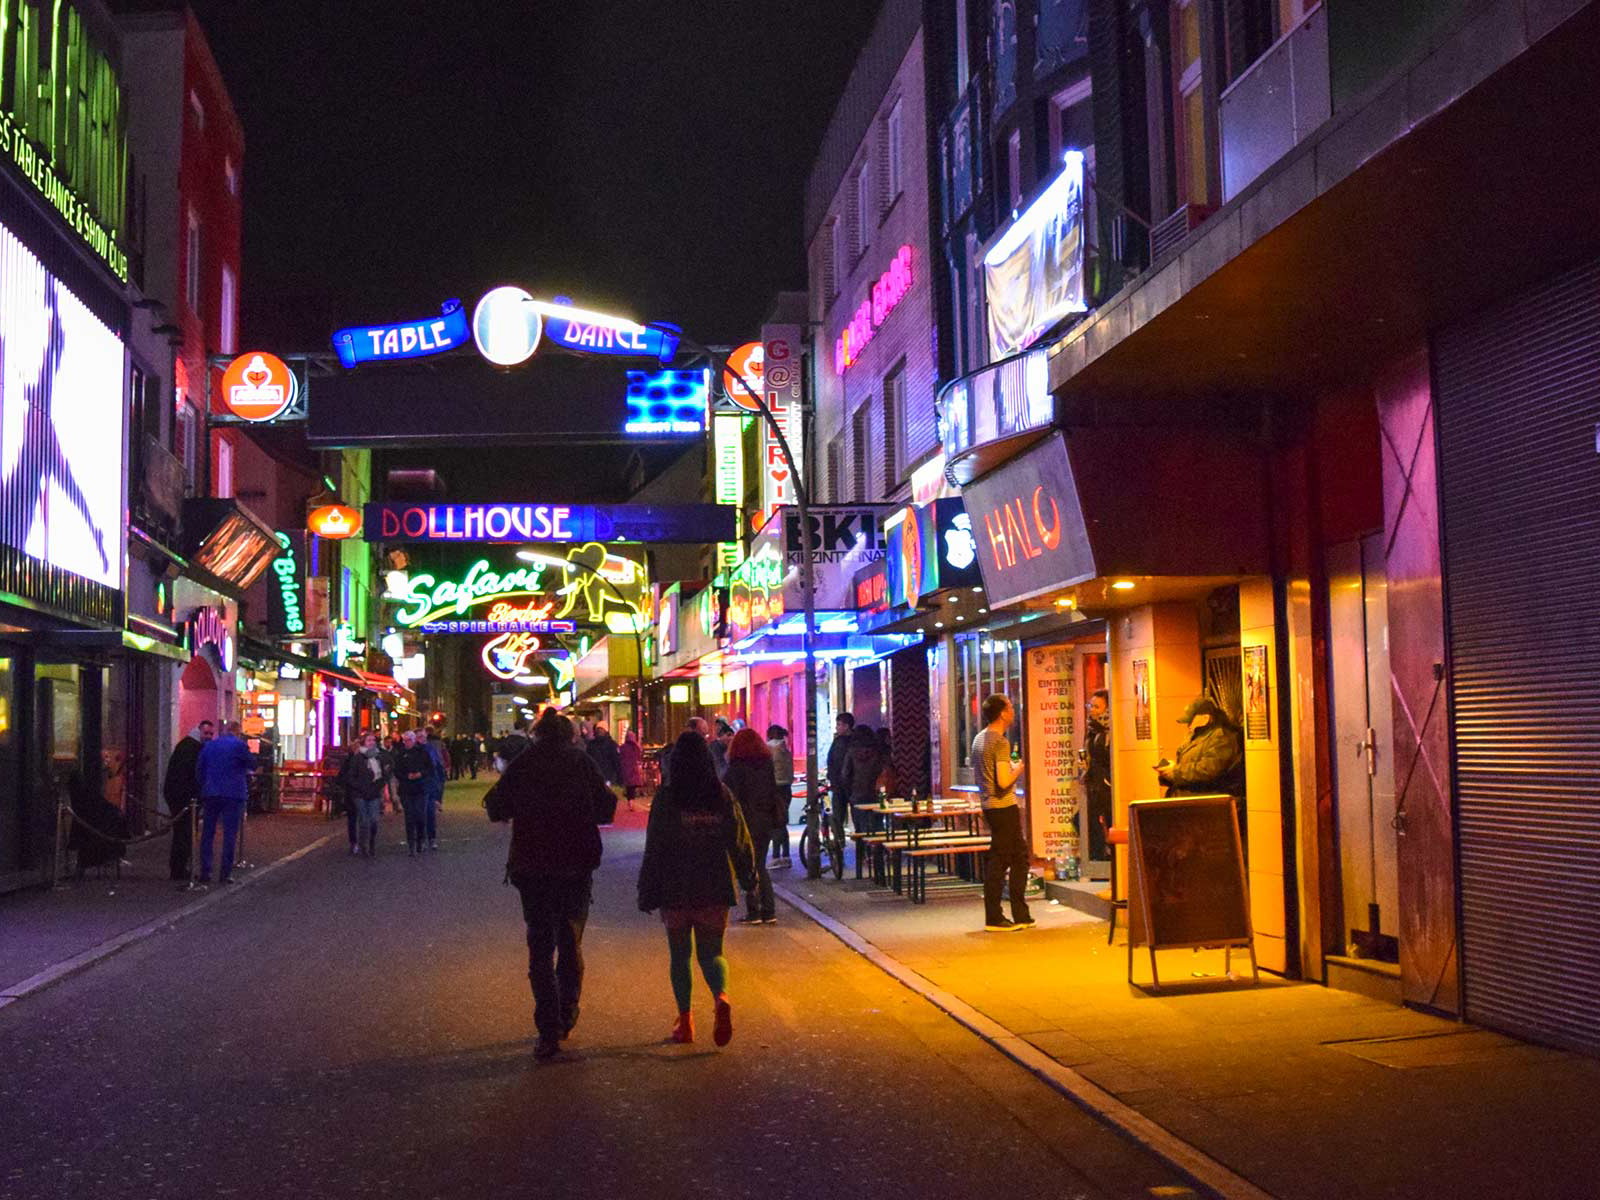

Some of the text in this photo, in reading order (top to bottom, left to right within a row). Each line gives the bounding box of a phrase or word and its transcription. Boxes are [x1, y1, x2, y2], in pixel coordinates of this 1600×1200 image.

[13, 128, 44, 192] TABLE
[45, 167, 75, 227] DANCE
[76, 204, 83, 235] &
[84, 212, 107, 260] SHOW
[109, 241, 128, 283] CLUB
[367, 321, 451, 355] TABLE
[564, 320, 648, 349] DANCE
[382, 507, 572, 538] DOLLHOUSE
[984, 486, 1061, 571] HALO
[397, 559, 547, 626] Safari
[449, 621, 549, 633] SPIELHALLE
[1040, 702, 1058, 711] LIVE
[1043, 717, 1073, 726] MIXED
[1043, 726, 1074, 735] MUSIC
[1046, 740, 1072, 749] LONG
[1044, 749, 1074, 758] DRINK
[1044, 759, 1075, 767] HAPPY
[1047, 767, 1074, 777] HOUR
[1051, 788, 1072, 796] ALLE
[1050, 807, 1074, 815] AUCH
[1050, 816, 1055, 824] 2
